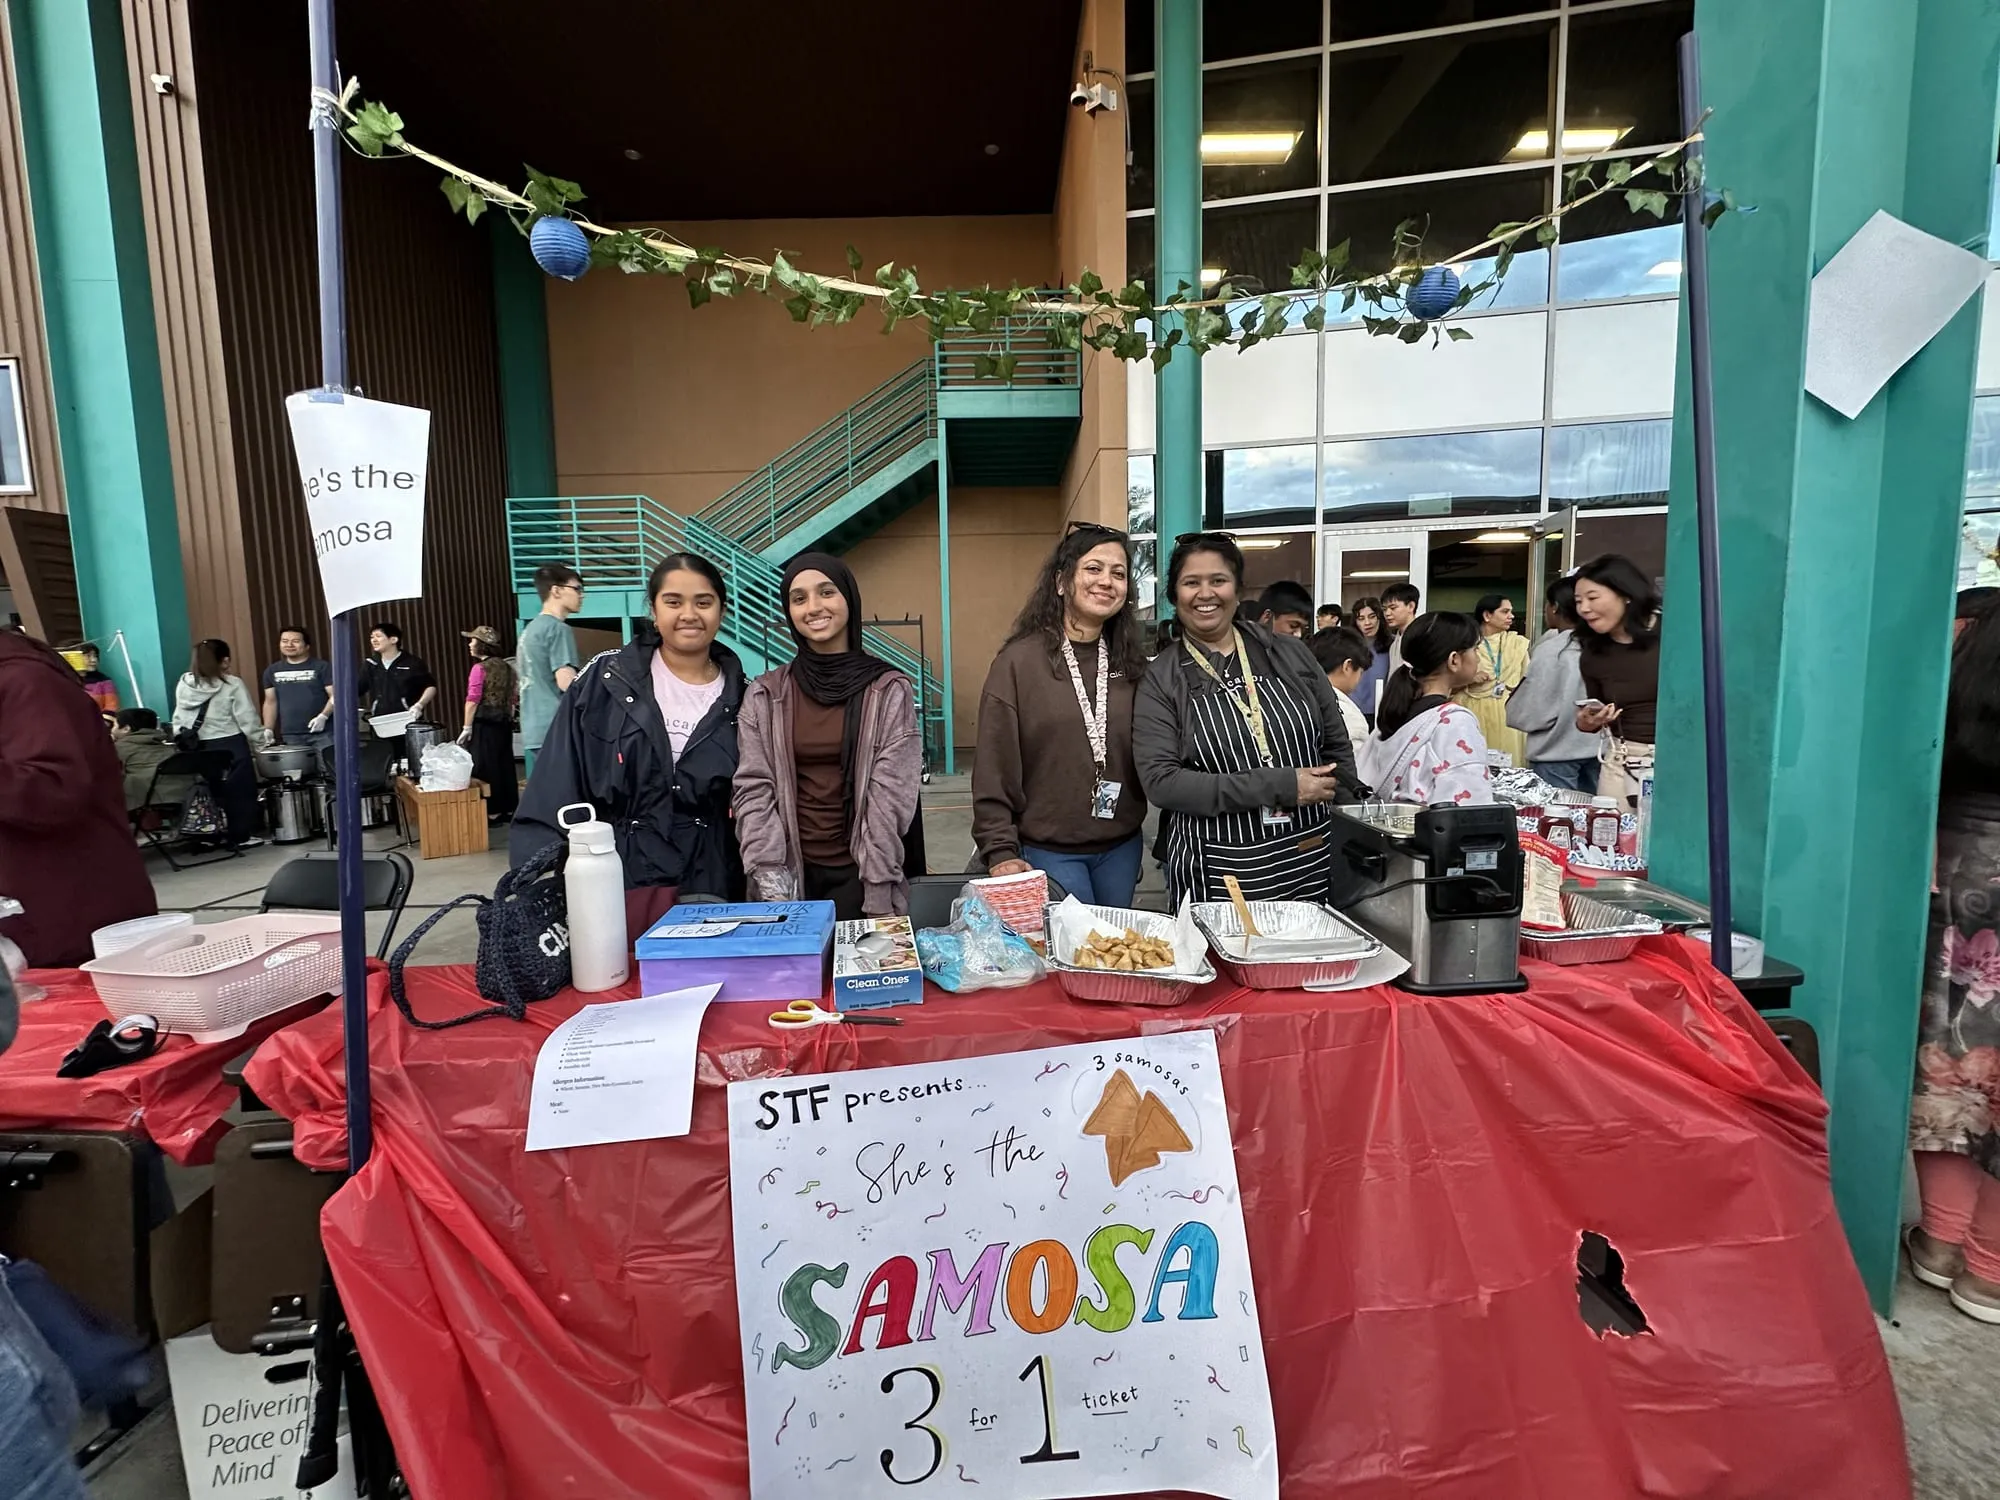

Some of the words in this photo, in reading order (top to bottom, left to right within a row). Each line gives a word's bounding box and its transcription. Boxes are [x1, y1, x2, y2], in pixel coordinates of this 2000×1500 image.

[352, 464, 414, 490] the
[683, 905, 737, 916] DROP
[765, 903, 813, 914] YOUR
[756, 923, 806, 937] HERE
[846, 979, 880, 990] Clean
[881, 975, 910, 986] Ones
[1093, 1054, 1106, 1072] 3
[1113, 1051, 1190, 1096] samosas
[754, 1084, 831, 1131] STF
[855, 1139, 955, 1203] She's
[975, 1124, 1045, 1178] the
[773, 1220, 1219, 1373] SAMOSA
[202, 1393, 309, 1428] Deliverin
[880, 1364, 946, 1485] 3
[969, 1408, 998, 1427] for
[1018, 1354, 1081, 1464] 1
[1082, 1386, 1139, 1408] ticket
[207, 1431, 275, 1458] Peace
[280, 1420, 307, 1446] of
